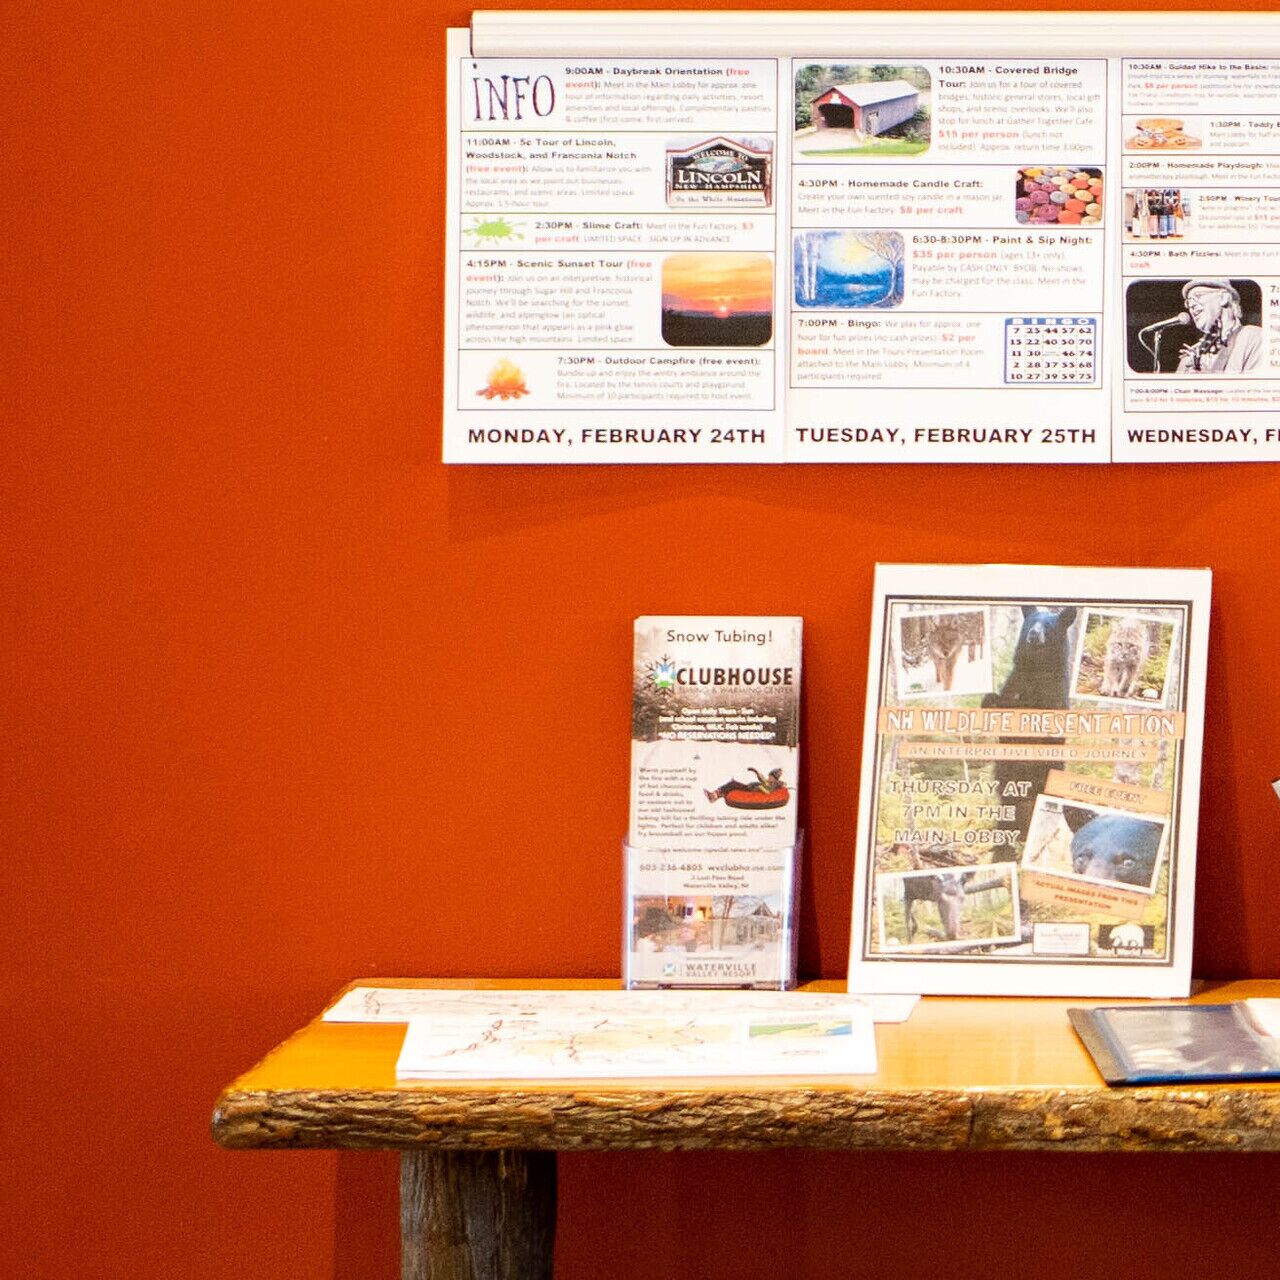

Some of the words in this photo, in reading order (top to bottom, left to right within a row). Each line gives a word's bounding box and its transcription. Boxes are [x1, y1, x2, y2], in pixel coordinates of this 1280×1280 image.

[564, 66, 604, 76] 9:00AM
[612, 66, 662, 77] Daybreak
[664, 67, 724, 76] Orientation
[938, 65, 986, 74] 10:30AM
[994, 65, 1040, 75] Covered
[1043, 66, 1078, 77] Bridge
[938, 79, 967, 88] Tour:
[466, 137, 511, 147] 11:00AM
[534, 137, 559, 147] Tour
[561, 138, 573, 147] of
[575, 138, 616, 148] Lincoln,
[465, 151, 526, 161] Woodstock,
[528, 152, 549, 160] and
[551, 151, 603, 160] Franconia
[605, 151, 637, 160] Notch
[678, 170, 761, 184] LINCOLN
[797, 178, 838, 188] 4:30PM
[847, 179, 910, 188] Homemade
[912, 179, 950, 188] Candle
[953, 179, 984, 188] Craft:
[912, 234, 982, 244] 6:30-8:30PM
[992, 235, 1022, 245] Paint
[1025, 235, 1034, 245] &
[1038, 235, 1056, 246] Sip
[1059, 235, 1093, 247] Night:
[465, 259, 507, 268] 4:15PM
[516, 259, 554, 268] Scenic
[557, 259, 595, 268] Sunset
[598, 259, 624, 268] Tour
[797, 318, 838, 328] 7:00PM
[847, 319, 881, 330] Bingo:
[557, 356, 596, 365] 7:30PM
[604, 356, 647, 365] Outdoor
[649, 356, 696, 366] Campfire
[468, 428, 573, 447] MONDAY,
[581, 428, 702, 444] FEBRUARY
[710, 428, 765, 444] 24TH
[795, 427, 906, 445] TUESDAY,
[914, 428, 1033, 444] FEBRUARY
[1041, 428, 1096, 444] 25TH
[1127, 428, 1258, 445] WEDNESDAY,
[667, 630, 709, 642] Snow
[715, 630, 772, 645] Tubing!
[676, 668, 793, 685] CLUBHOUSE
[888, 710, 913, 731] NH
[921, 711, 1012, 734] WILDLIFE
[890, 780, 999, 796] THURSDAY
[1002, 781, 1032, 798] AT
[902, 804, 945, 818] 7PM
[949, 805, 968, 818] IN
[976, 806, 1016, 820] THE
[894, 830, 946, 844] MAIN
[952, 830, 1020, 844] LOBBY
